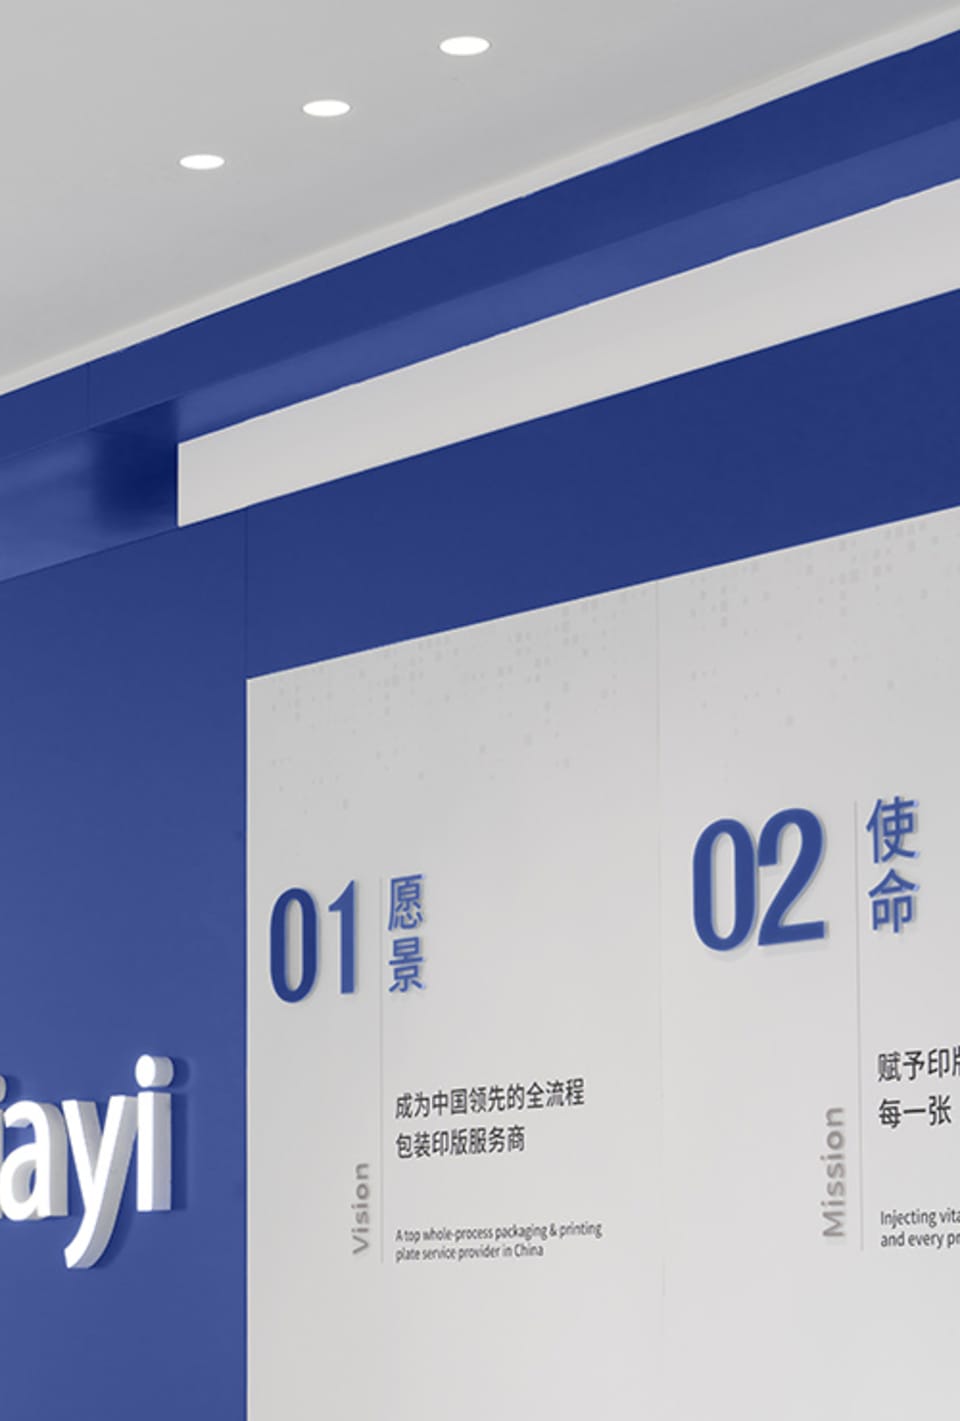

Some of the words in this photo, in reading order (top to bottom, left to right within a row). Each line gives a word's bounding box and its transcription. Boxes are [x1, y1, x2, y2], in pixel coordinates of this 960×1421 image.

[692, 808, 827, 951] 02
[866, 796, 920, 933] 使命
[269, 880, 358, 1003] 01
[388, 873, 427, 993] 愿景
[395, 1078, 585, 1119] 成为中国领先的全流程
[878, 1095, 952, 1128] 每一张
[395, 1125, 525, 1158] 包装印版服务商
[820, 1107, 846, 1237] Mission
[352, 1163, 371, 1255] Vision
[881, 1209, 937, 1228] Injecting
[395, 1230, 403, 1241] A
[404, 1230, 421, 1244] top
[423, 1227, 493, 1242] whole-process
[495, 1224, 548, 1241] packaging
[549, 1224, 558, 1237] &
[559, 1221, 603, 1239] printing
[395, 1248, 420, 1263] plate
[422, 1247, 456, 1260] service
[458, 1245, 500, 1261] provider
[502, 1244, 513, 1257] in
[514, 1243, 544, 1257] China
[881, 1232, 905, 1248] and
[907, 1232, 943, 1249] every
